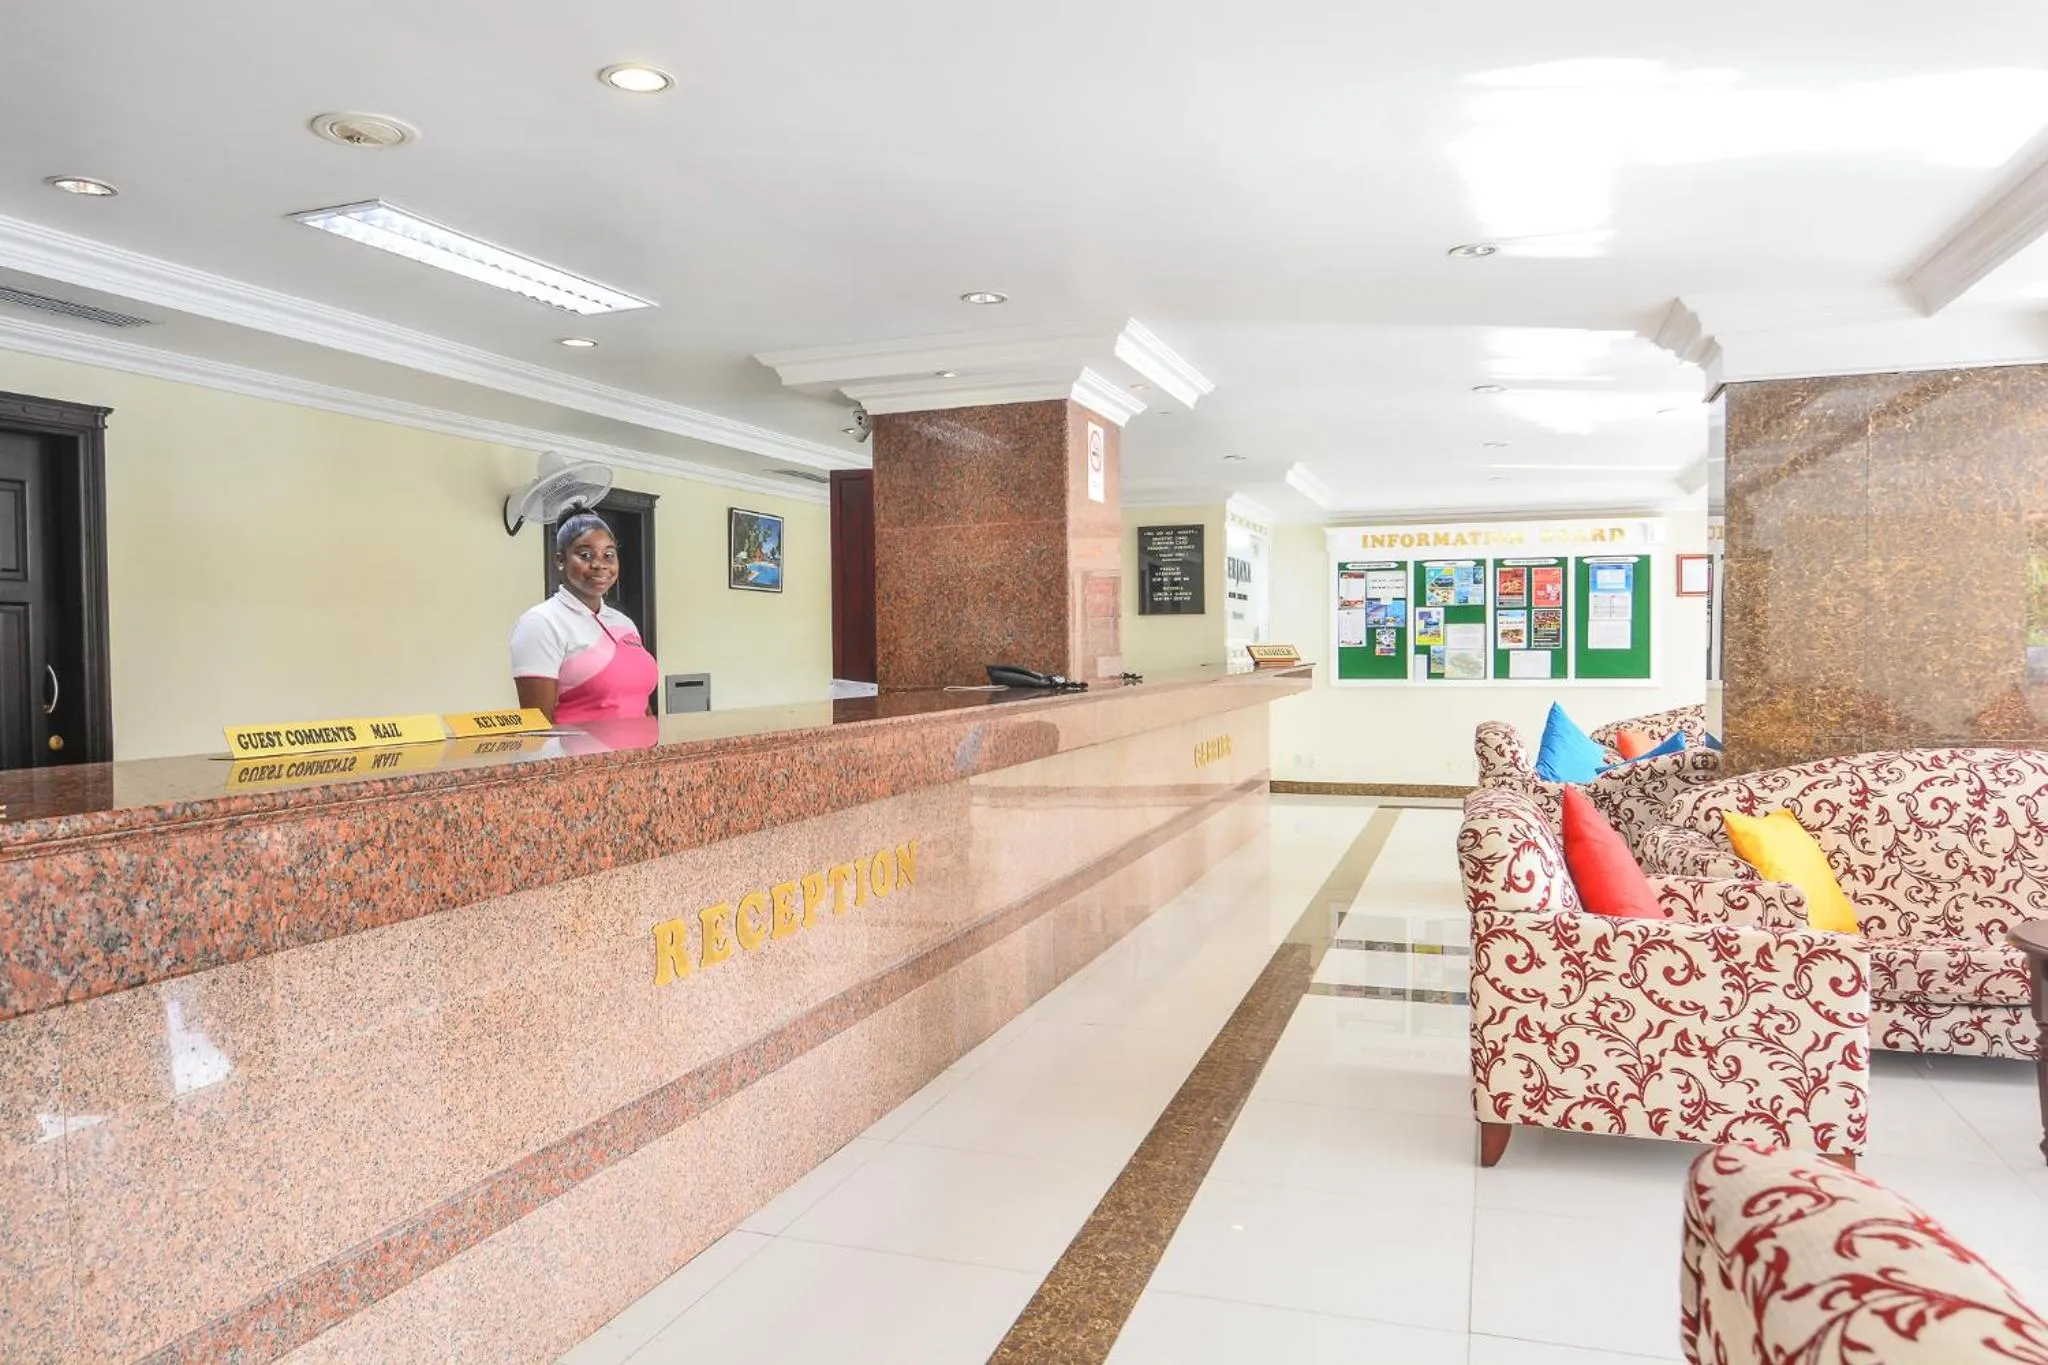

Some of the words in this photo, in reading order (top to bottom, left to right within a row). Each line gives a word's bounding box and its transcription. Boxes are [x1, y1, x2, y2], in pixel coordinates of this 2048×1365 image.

[473, 715, 497, 729] KEY
[496, 714, 523, 727] DROP
[237, 729, 282, 750] GUEST
[285, 726, 357, 746] COMMENTS
[370, 723, 402, 739] MAIL
[652, 841, 918, 986] RECEPTION
